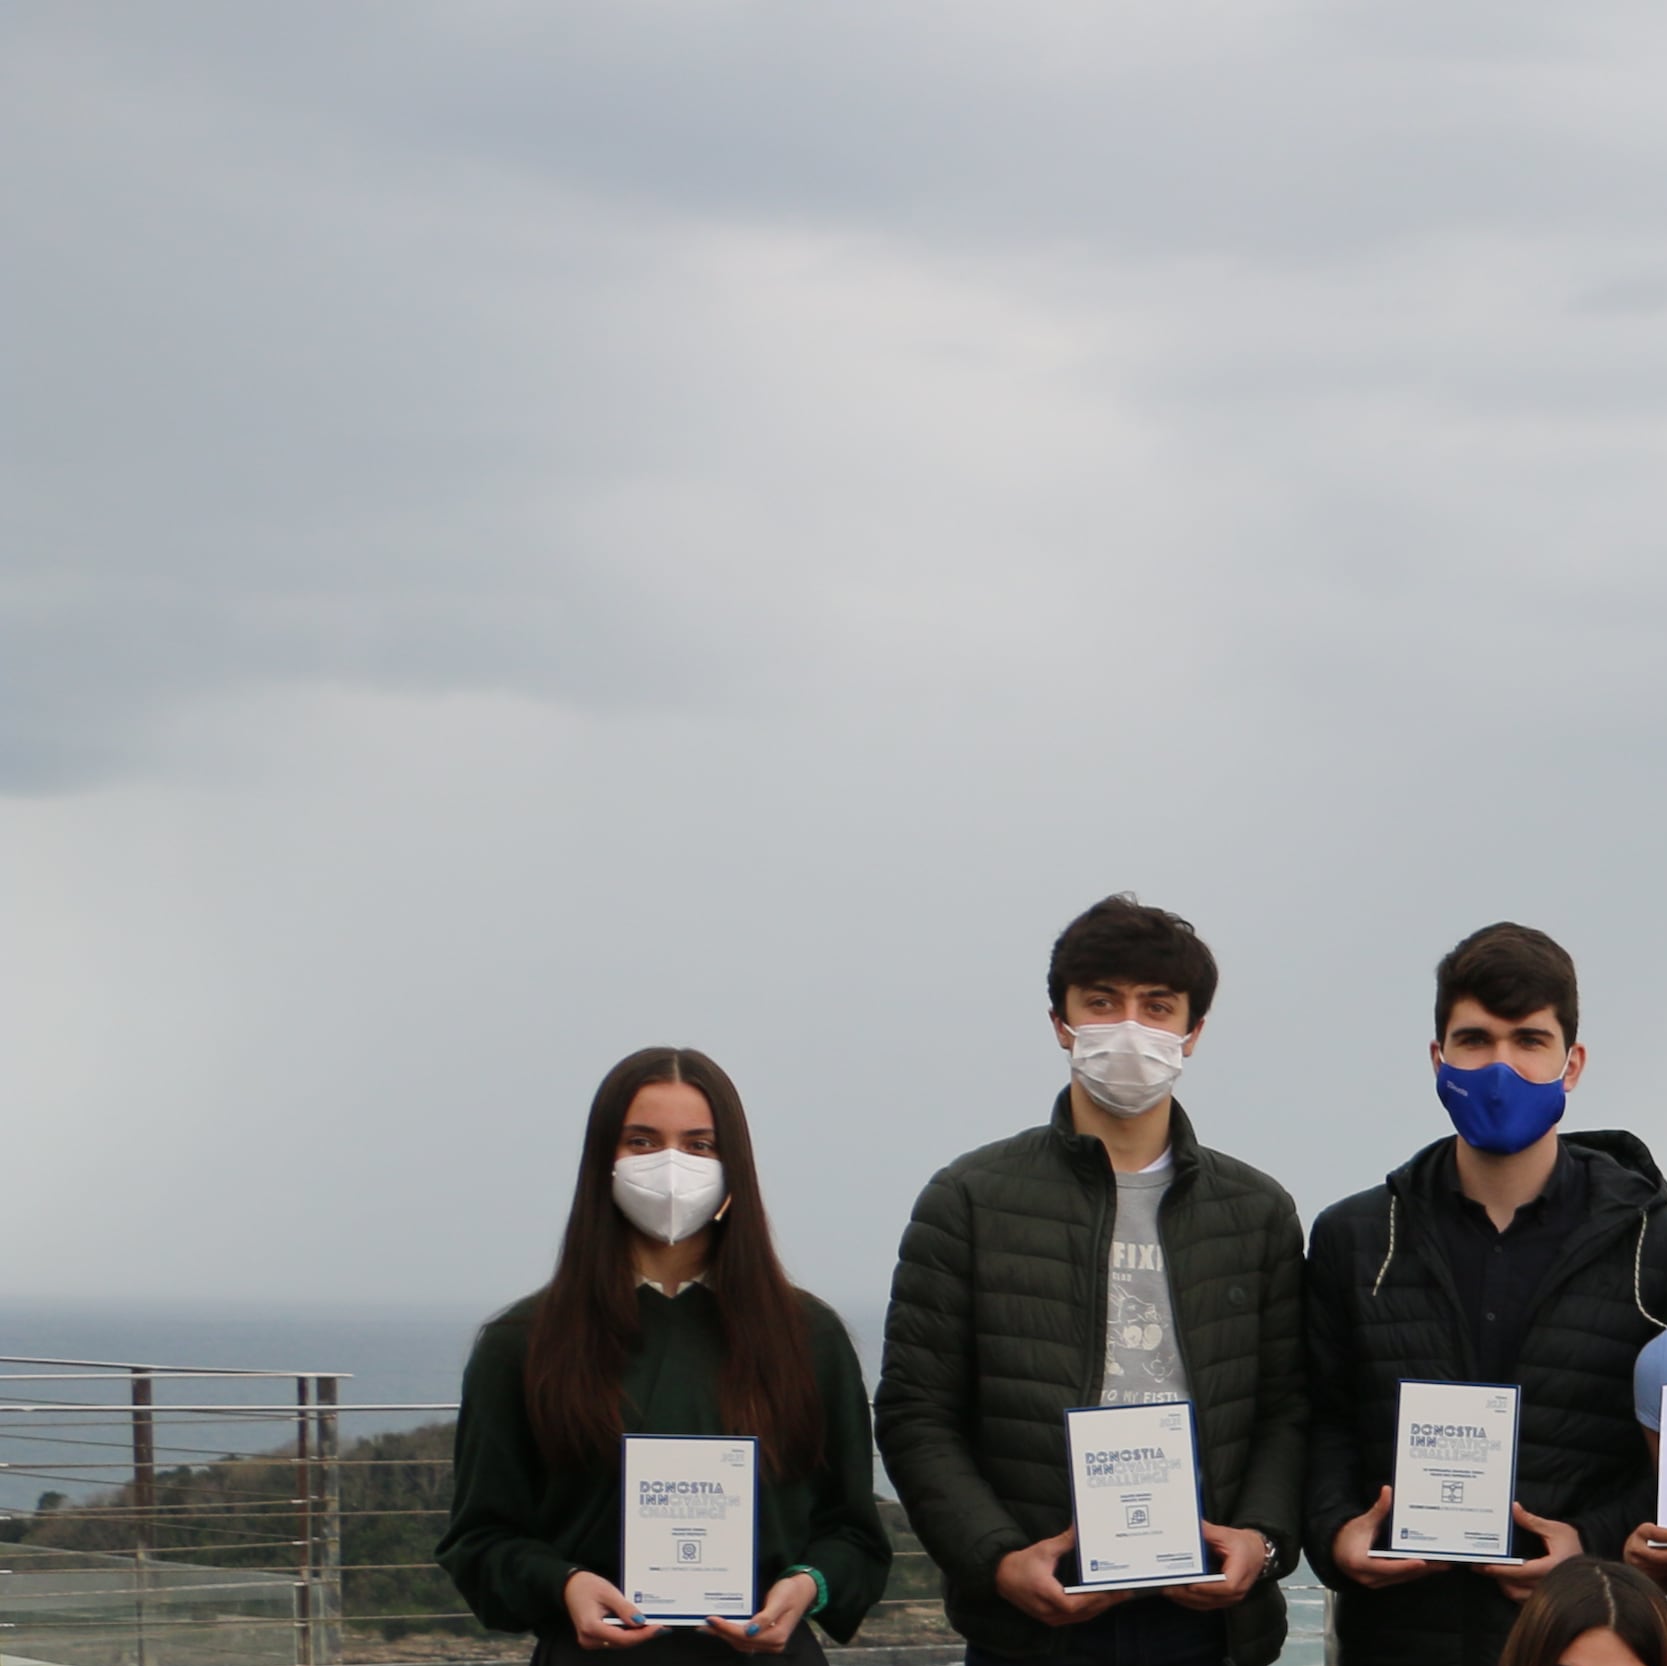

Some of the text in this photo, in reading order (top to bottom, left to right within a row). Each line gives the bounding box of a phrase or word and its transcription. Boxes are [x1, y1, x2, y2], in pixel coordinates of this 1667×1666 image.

[1411, 1423, 1486, 1438] DONOSTIA
[1410, 1436, 1502, 1450] INNOVATION
[1085, 1448, 1164, 1464] DONOSTIA
[1410, 1447, 1488, 1462] CHALLENGE
[1086, 1459, 1181, 1476] INNOVATION
[1087, 1470, 1168, 1488] CHALLENGE
[640, 1481, 723, 1493] DONOSTIA
[640, 1494, 740, 1507] INNOVATION
[639, 1505, 726, 1520] CHALLENGE
